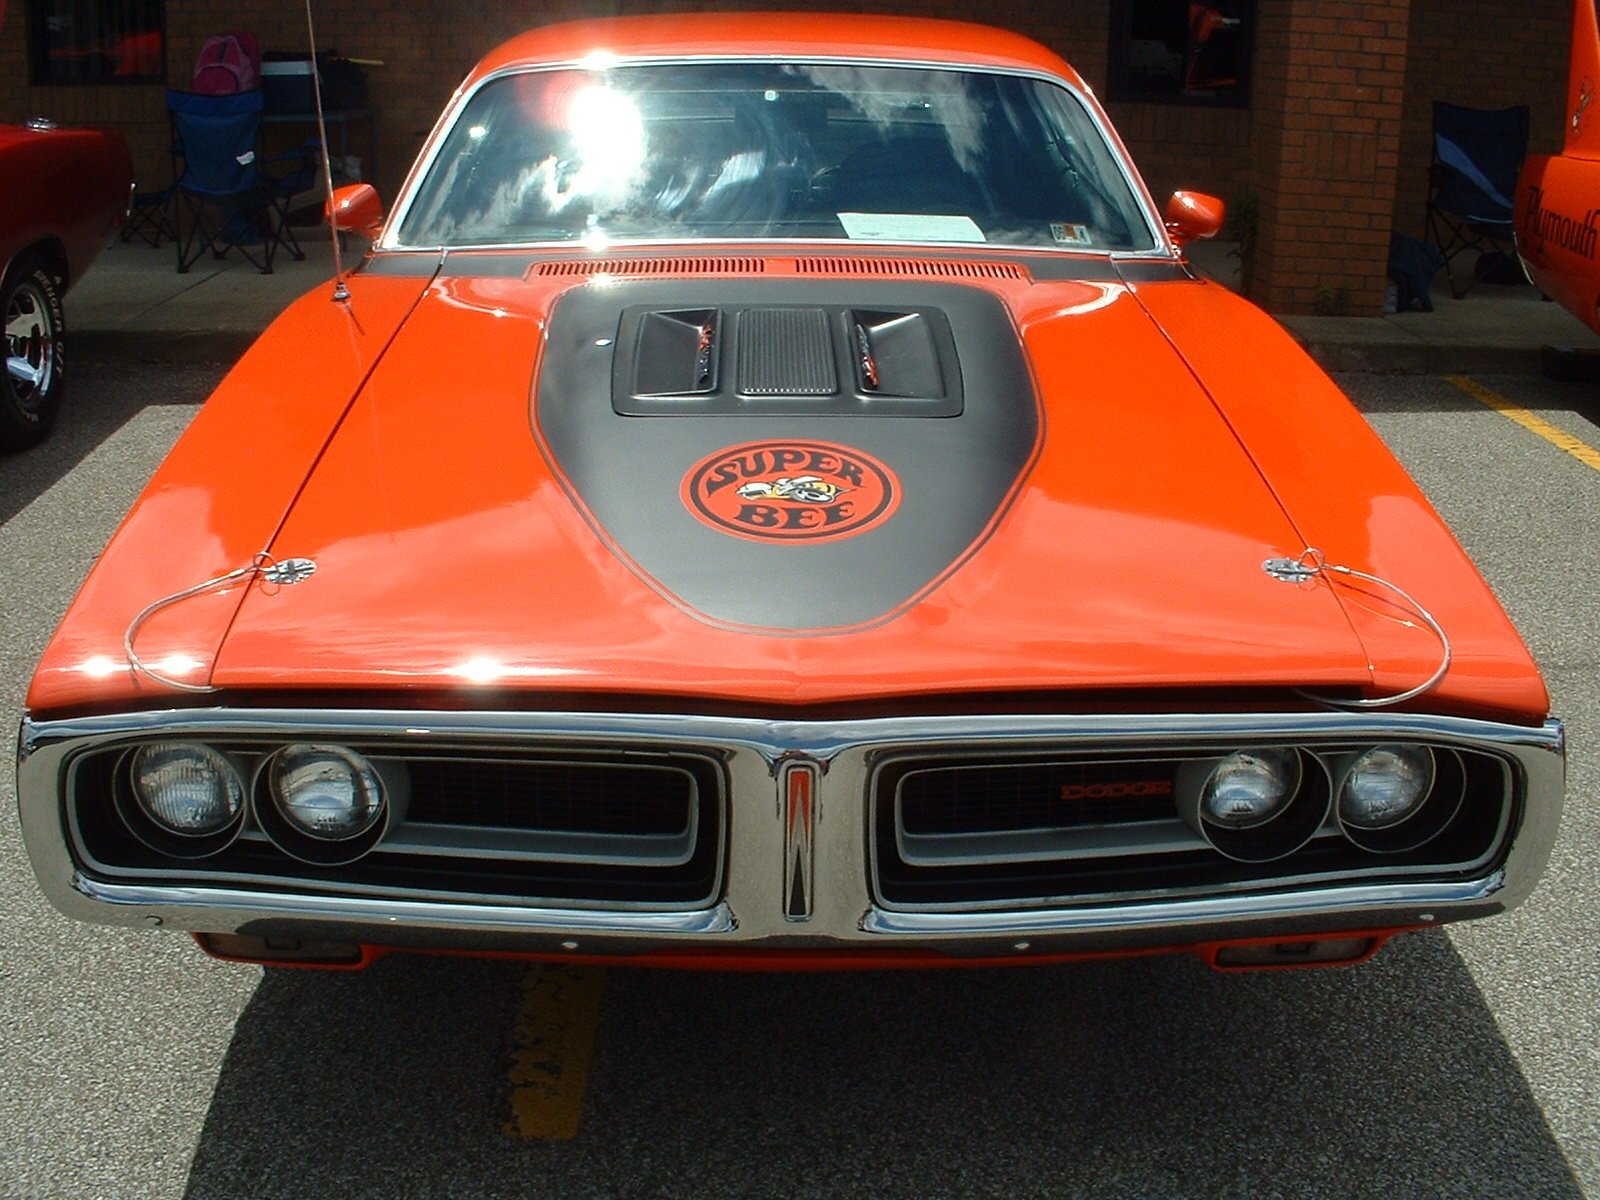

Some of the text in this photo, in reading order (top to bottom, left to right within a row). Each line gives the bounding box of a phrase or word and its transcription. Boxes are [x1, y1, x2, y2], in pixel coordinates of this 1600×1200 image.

[1521, 185, 1600, 260] Plymouth
[706, 450, 865, 498] SUPER
[733, 501, 856, 529] BEE
[1062, 781, 1171, 800] DODGE
